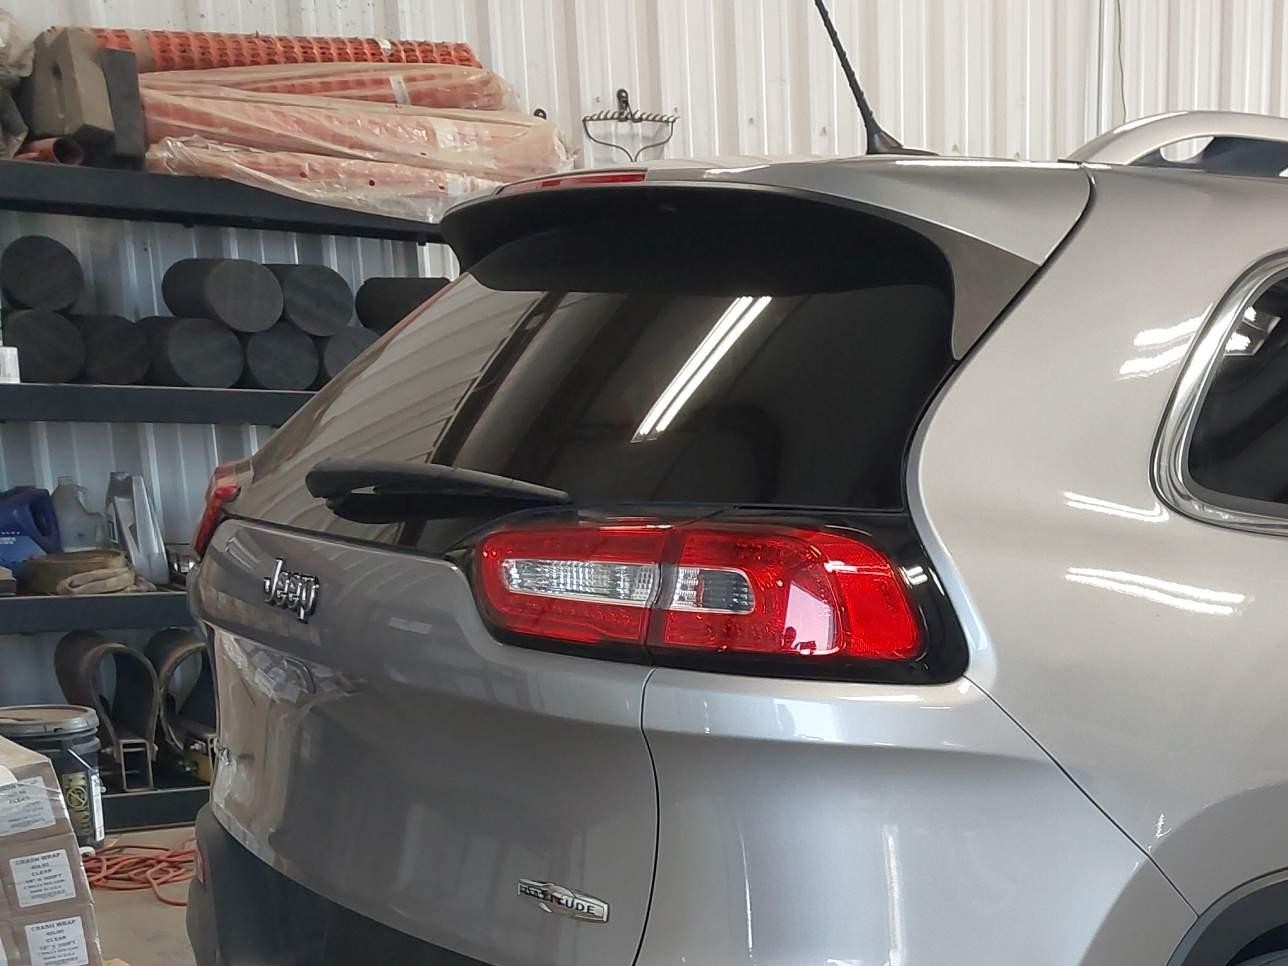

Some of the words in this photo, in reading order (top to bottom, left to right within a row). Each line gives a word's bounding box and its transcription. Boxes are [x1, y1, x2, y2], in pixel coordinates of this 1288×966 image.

[264, 558, 319, 621] Jeep
[31, 923, 55, 932] CRASH
[56, 919, 76, 927] WRAP
